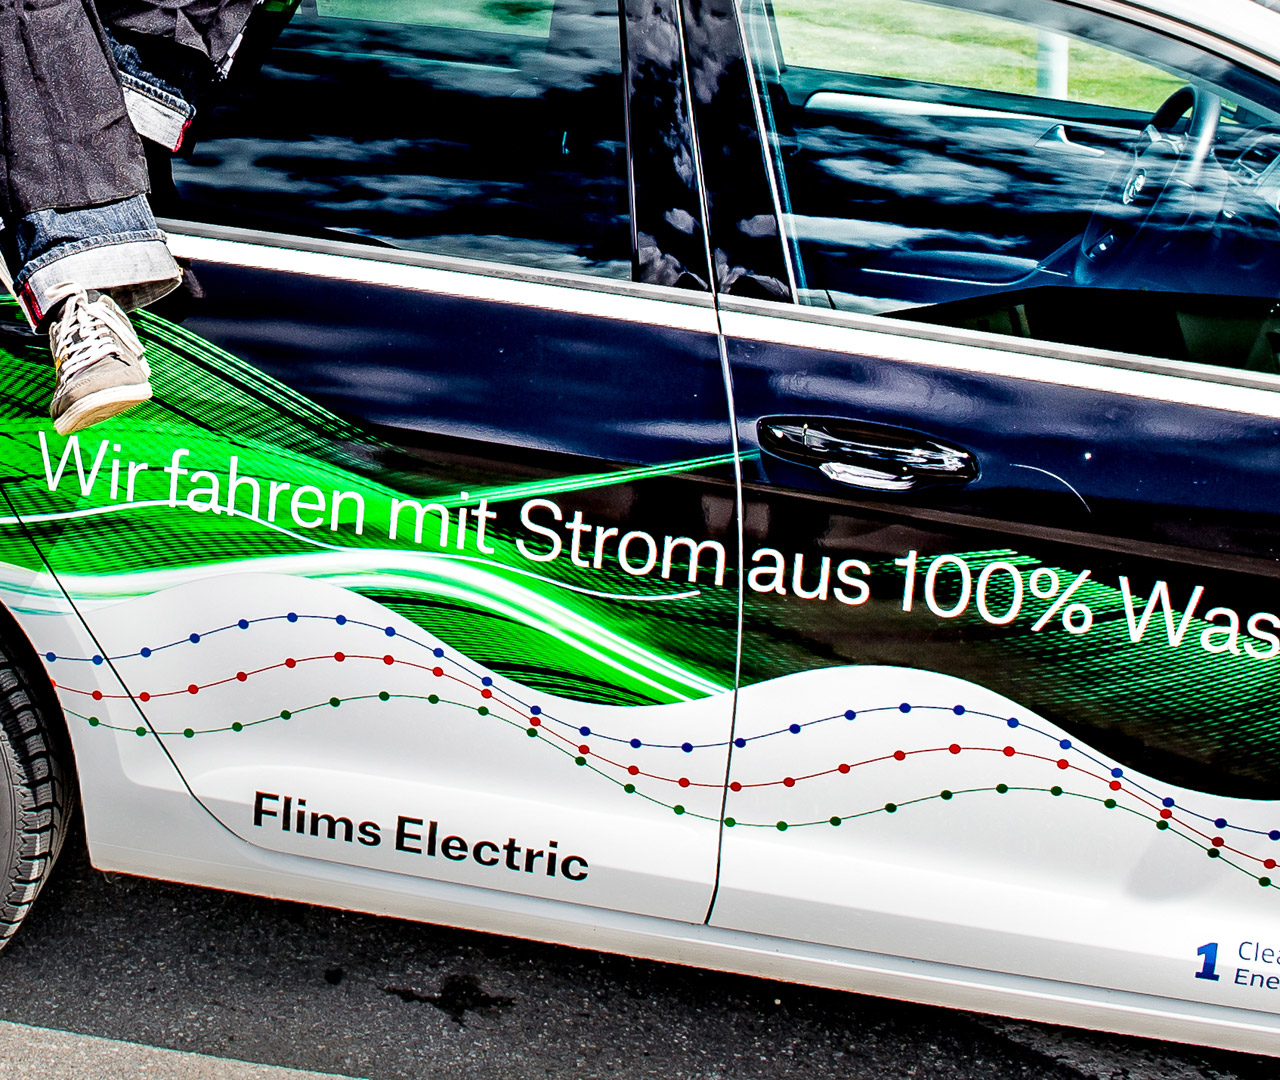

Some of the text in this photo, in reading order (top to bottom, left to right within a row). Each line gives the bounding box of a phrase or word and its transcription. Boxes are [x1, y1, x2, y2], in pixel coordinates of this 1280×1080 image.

[38, 431, 148, 502] Wir
[164, 448, 365, 535] fahren
[389, 491, 497, 554] mit
[516, 498, 726, 586] Strom
[747, 548, 871, 606] aus
[894, 549, 1093, 635] 100%
[253, 790, 589, 882] Flims Electric
[1195, 942, 1220, 982] 1
[1234, 968, 1280, 990] Ene
